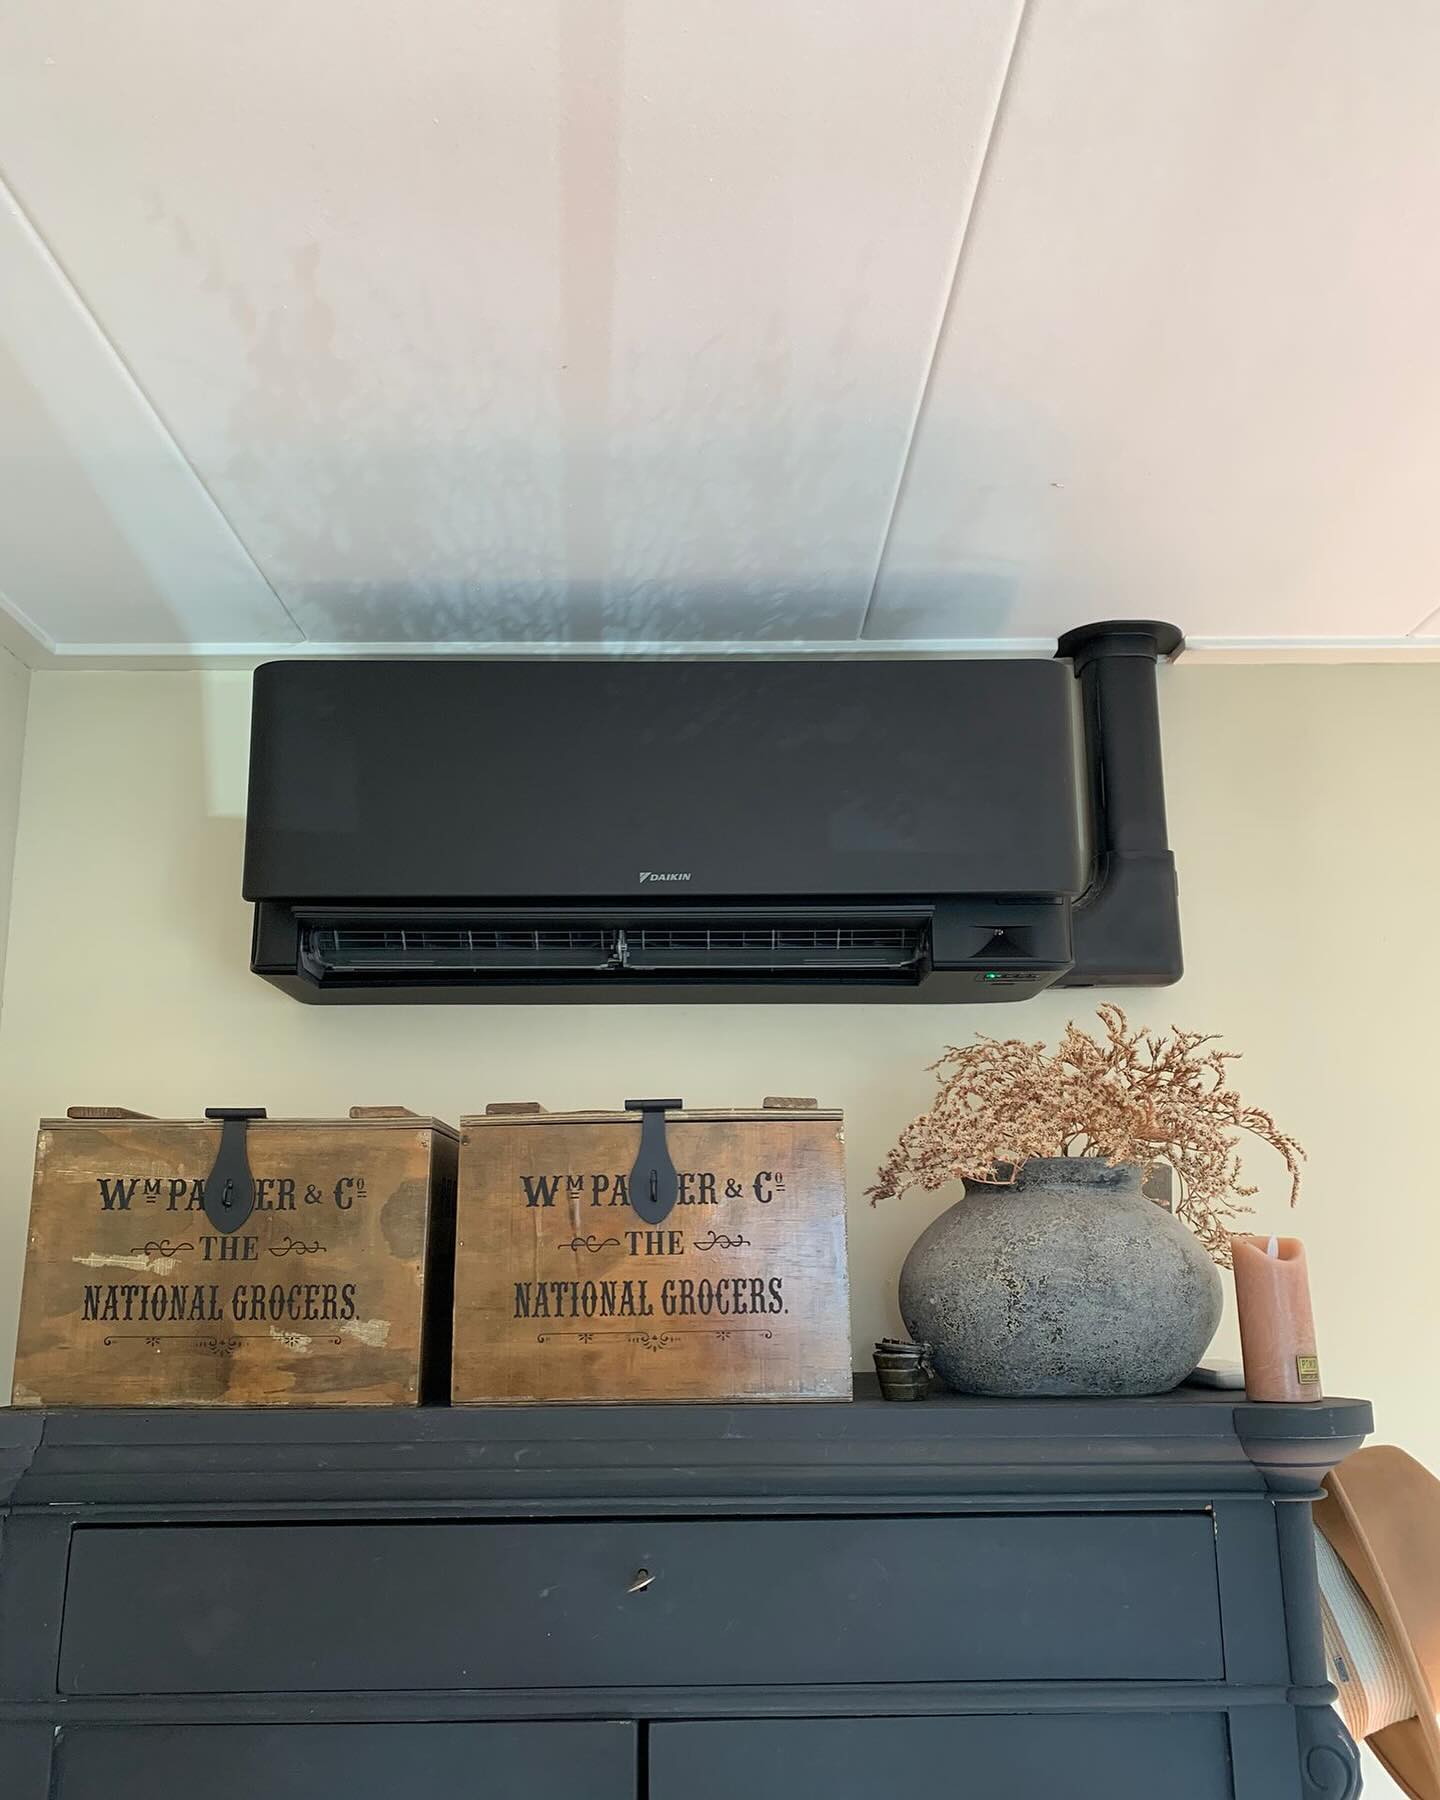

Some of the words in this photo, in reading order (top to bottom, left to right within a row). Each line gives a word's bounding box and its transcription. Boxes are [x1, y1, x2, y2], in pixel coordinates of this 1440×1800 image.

[649, 873, 692, 881] DAIKIN
[165, 1178, 297, 1211] PAER
[303, 1184, 324, 1205] &
[590, 1172, 719, 1206] PAER
[724, 1178, 745, 1198] &
[199, 1235, 259, 1261] THE
[624, 1230, 685, 1256] THE
[81, 1284, 224, 1321] NATIONAL
[231, 1283, 360, 1321] GROCERS.
[513, 1279, 655, 1318] NATIONAL
[660, 1276, 789, 1316] GROCERS.
